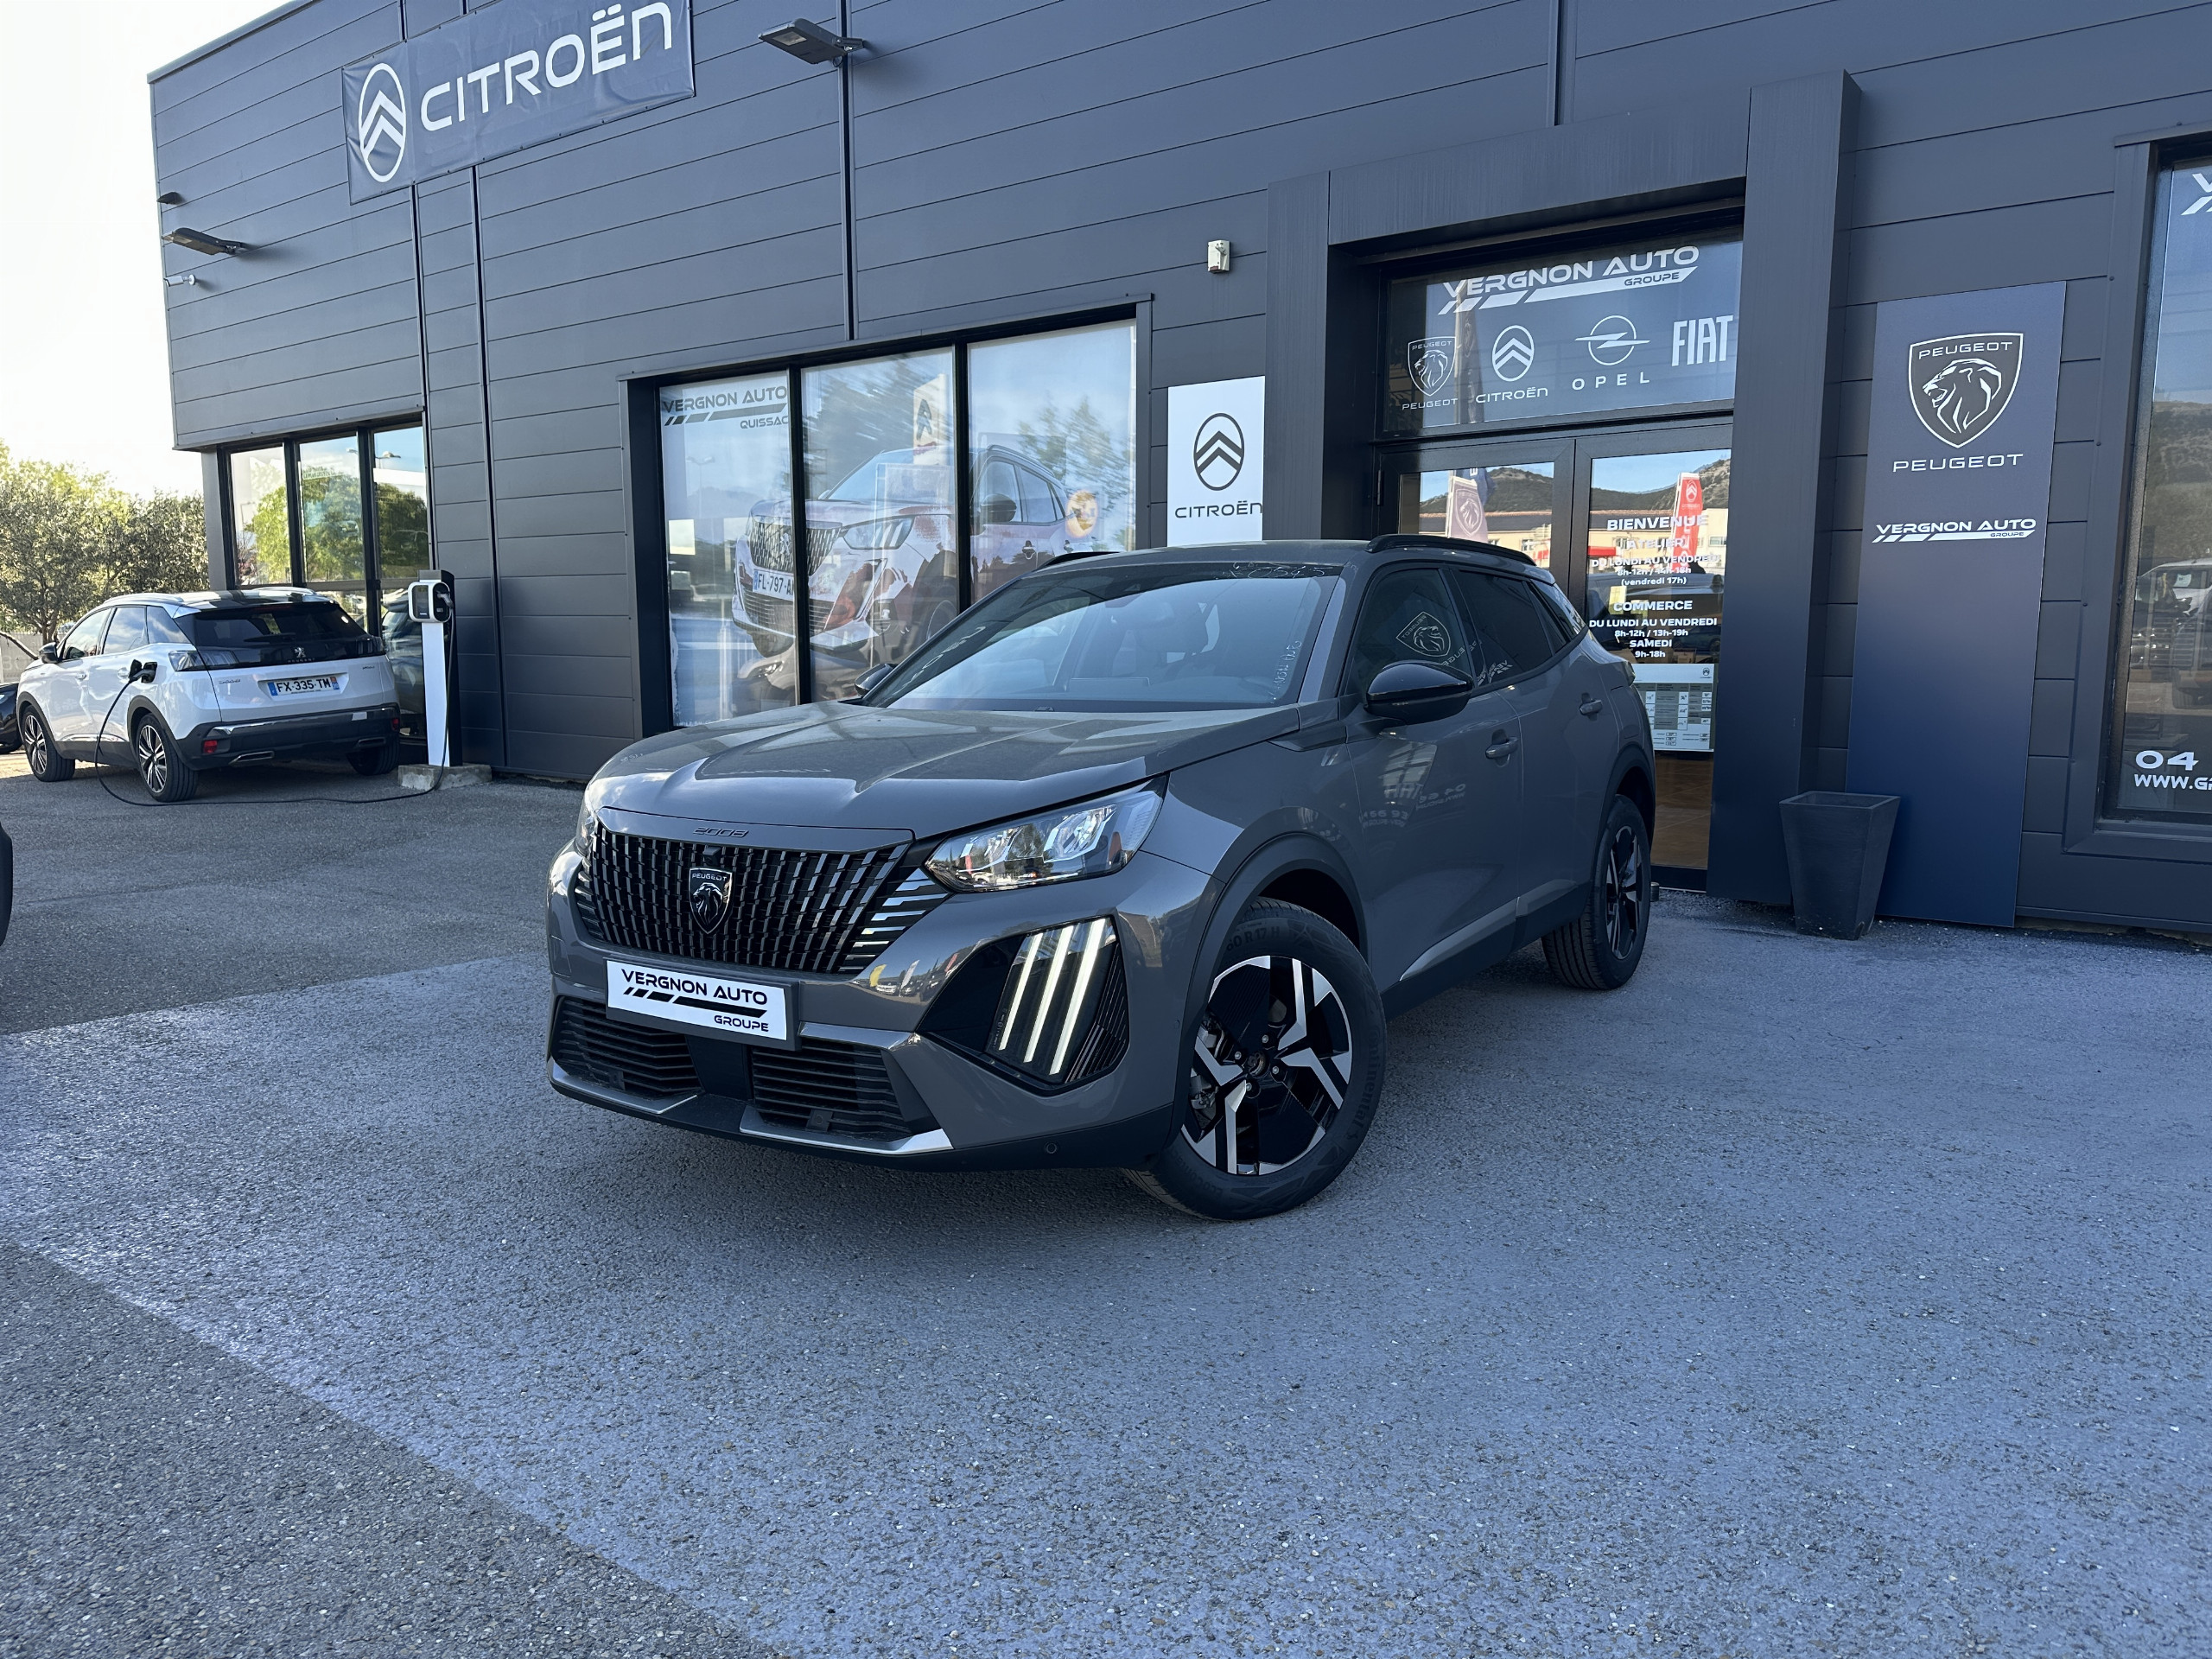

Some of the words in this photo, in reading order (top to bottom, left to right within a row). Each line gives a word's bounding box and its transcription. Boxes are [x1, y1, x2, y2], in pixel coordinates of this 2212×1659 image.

[420, 2, 672, 131] CITROËN
[1443, 261, 1593, 298] VERGNON
[1603, 245, 1700, 277] AUTO
[1624, 272, 1680, 287] GROUPE
[1412, 340, 1452, 350] PEUGEOT
[1671, 315, 1734, 366] FIAT
[1918, 341, 2013, 359] PEUGEOT
[1572, 372, 1650, 391] OPEL
[663, 392, 738, 413] VERGNON
[742, 386, 789, 404] AUTO
[1475, 386, 1548, 404] CITROËN
[1402, 398, 1459, 410] PEUGEOT
[740, 416, 790, 429] QUISSAC
[1892, 454, 2024, 472] PEUGEOT
[1174, 500, 1262, 518] CITROËN
[1607, 514, 1708, 531] BIENVENUE
[1876, 520, 1973, 534] VERGNON
[1977, 518, 2037, 531] AUTO
[1626, 537, 1685, 550] ATELIER
[1592, 557, 1607, 568] DU
[1609, 556, 1643, 566] LUNDI
[1644, 556, 1660, 565] AU
[1662, 553, 1721, 564] VENDREDI
[1617, 567, 1649, 576] 8h-12h
[1621, 577, 1665, 586] (vendredi
[1666, 576, 1688, 586] 17h)
[1613, 601, 1693, 612] COMMERCE
[1589, 620, 1605, 628] DU
[1606, 619, 1639, 627] LUNDI
[1641, 619, 1657, 627] AU
[1659, 618, 1718, 626] VENDREDI
[1629, 639, 1673, 648] SAMEDI
[2135, 750, 2199, 771] 04
[692, 826, 750, 838] 2008
[692, 873, 728, 881] PEUGEOT
[621, 969, 708, 996] VERGNON
[713, 985, 768, 1006] AUTO
[714, 1014, 769, 1032] GROUPE
